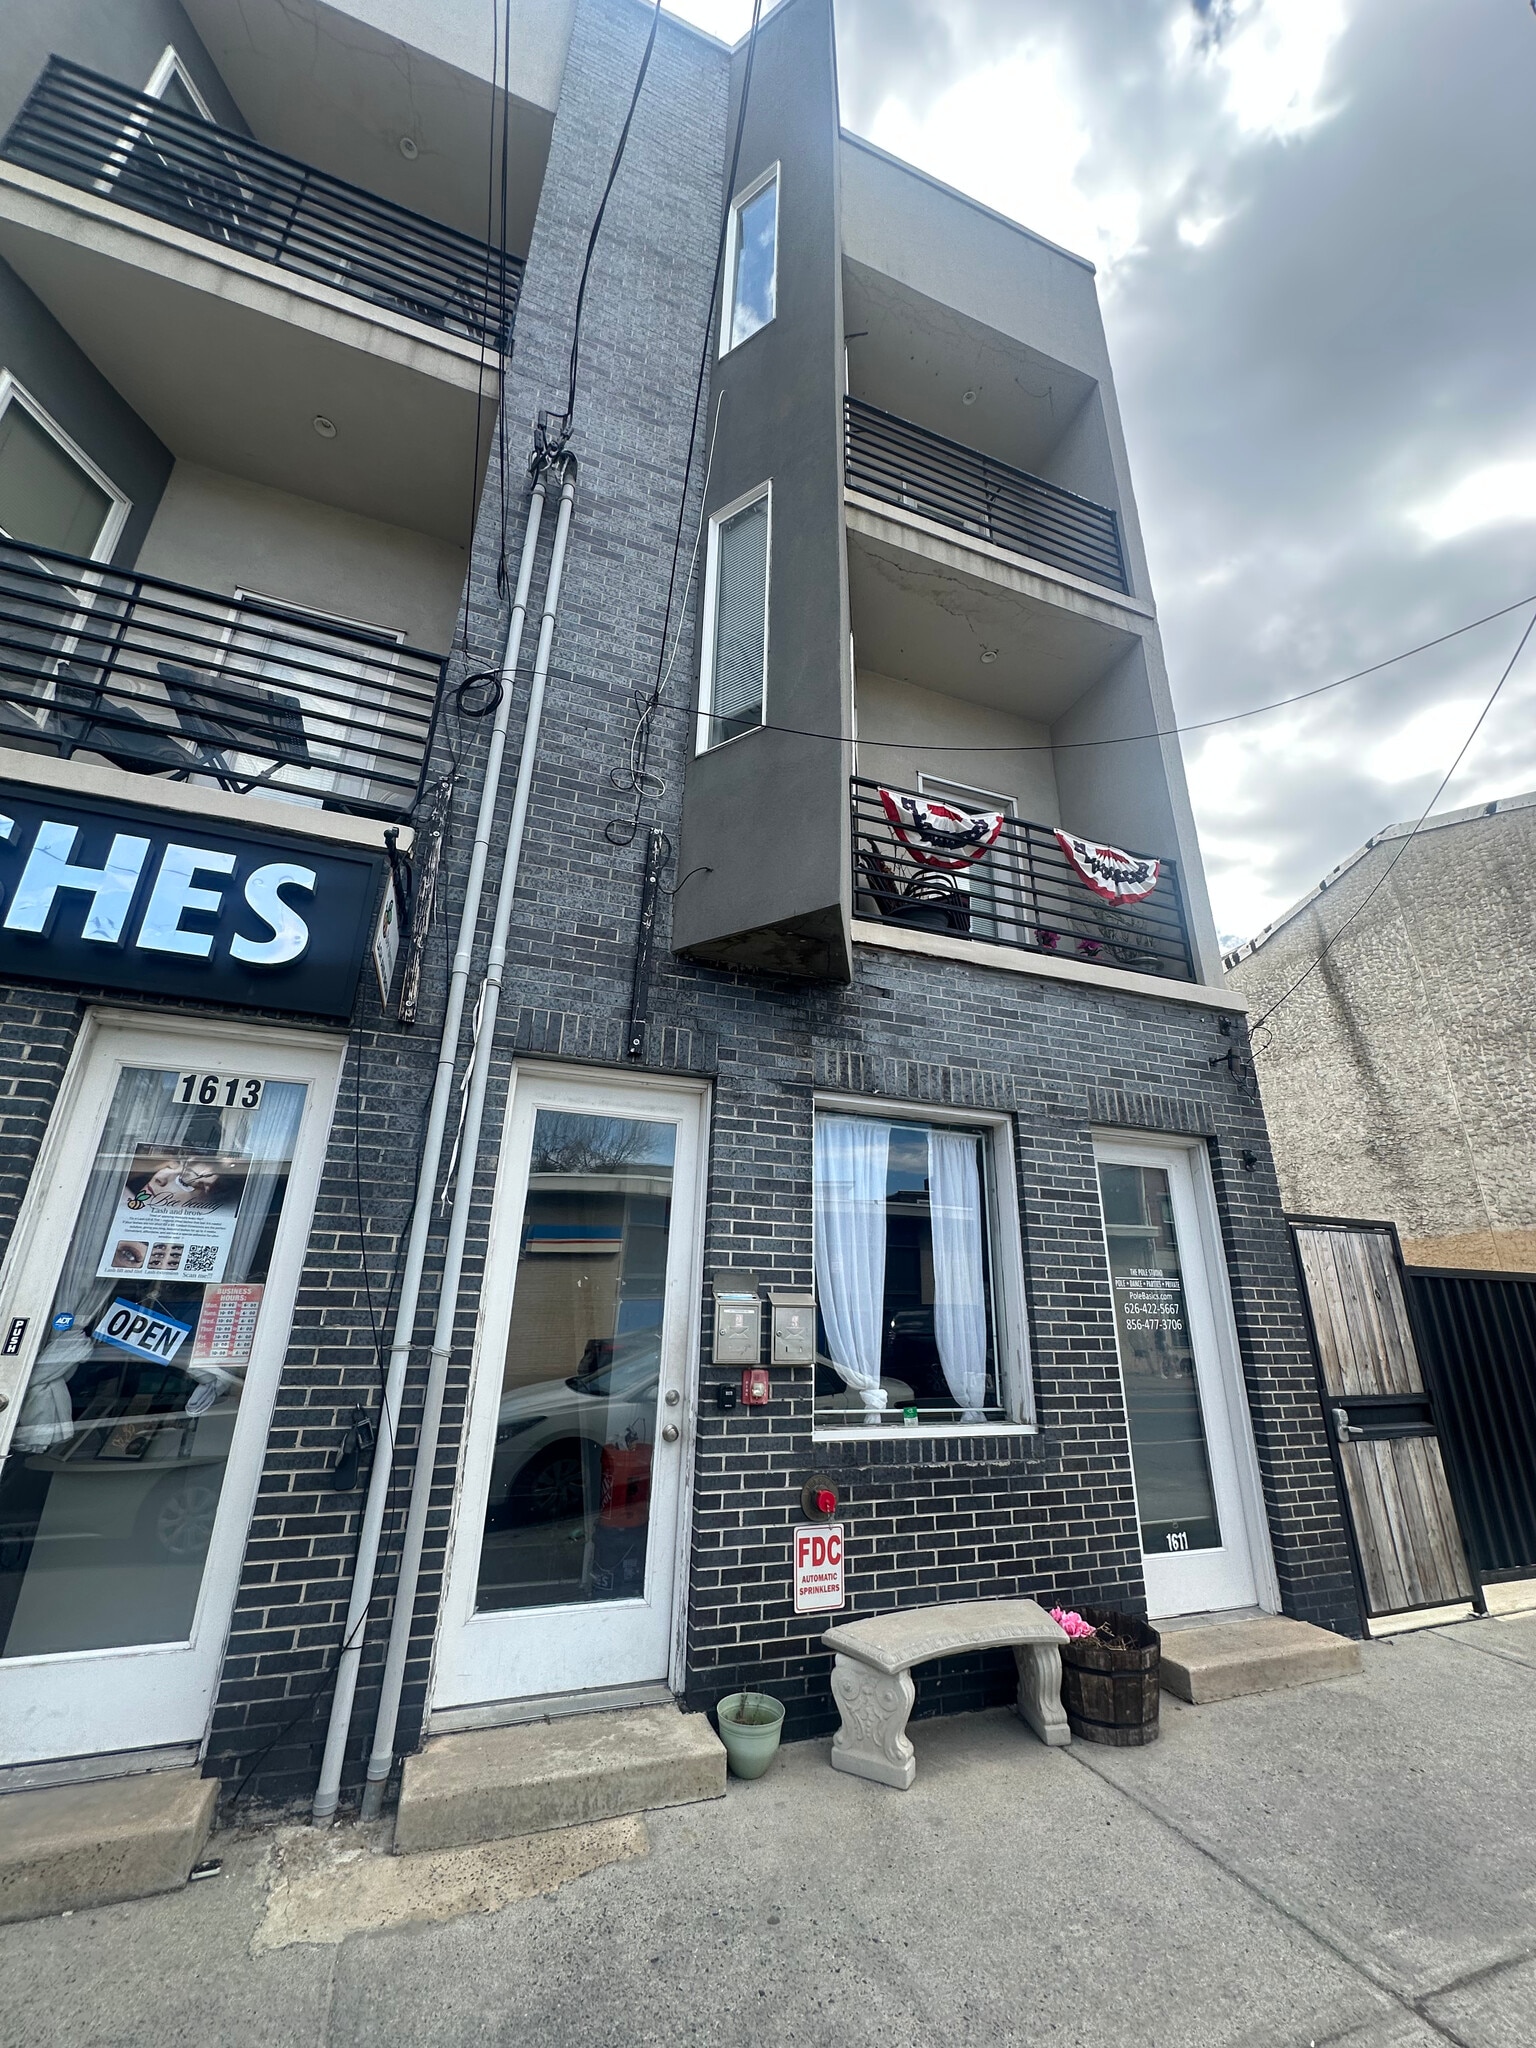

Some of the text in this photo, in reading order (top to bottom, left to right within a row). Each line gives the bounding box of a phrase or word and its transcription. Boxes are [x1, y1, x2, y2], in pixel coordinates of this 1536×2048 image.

[0, 813, 317, 964] HES
[182, 1074, 261, 1108] 1613
[148, 1192, 181, 1209] Bee
[151, 1207, 169, 1215] Lash
[1129, 1292, 1173, 1300] PoleBasics.com
[1124, 1303, 1179, 1314] 626-422-5667
[55, 1317, 73, 1325] ADT
[1126, 1319, 1182, 1330] 856-477-3706
[7, 1320, 24, 1353] PUSH
[107, 1309, 181, 1357] OPEN
[1166, 1532, 1188, 1551] 1611
[798, 1535, 842, 1568] FDC
[802, 1572, 838, 1584] AUTOMATIC
[800, 1584, 840, 1596] SPRINKLERS
